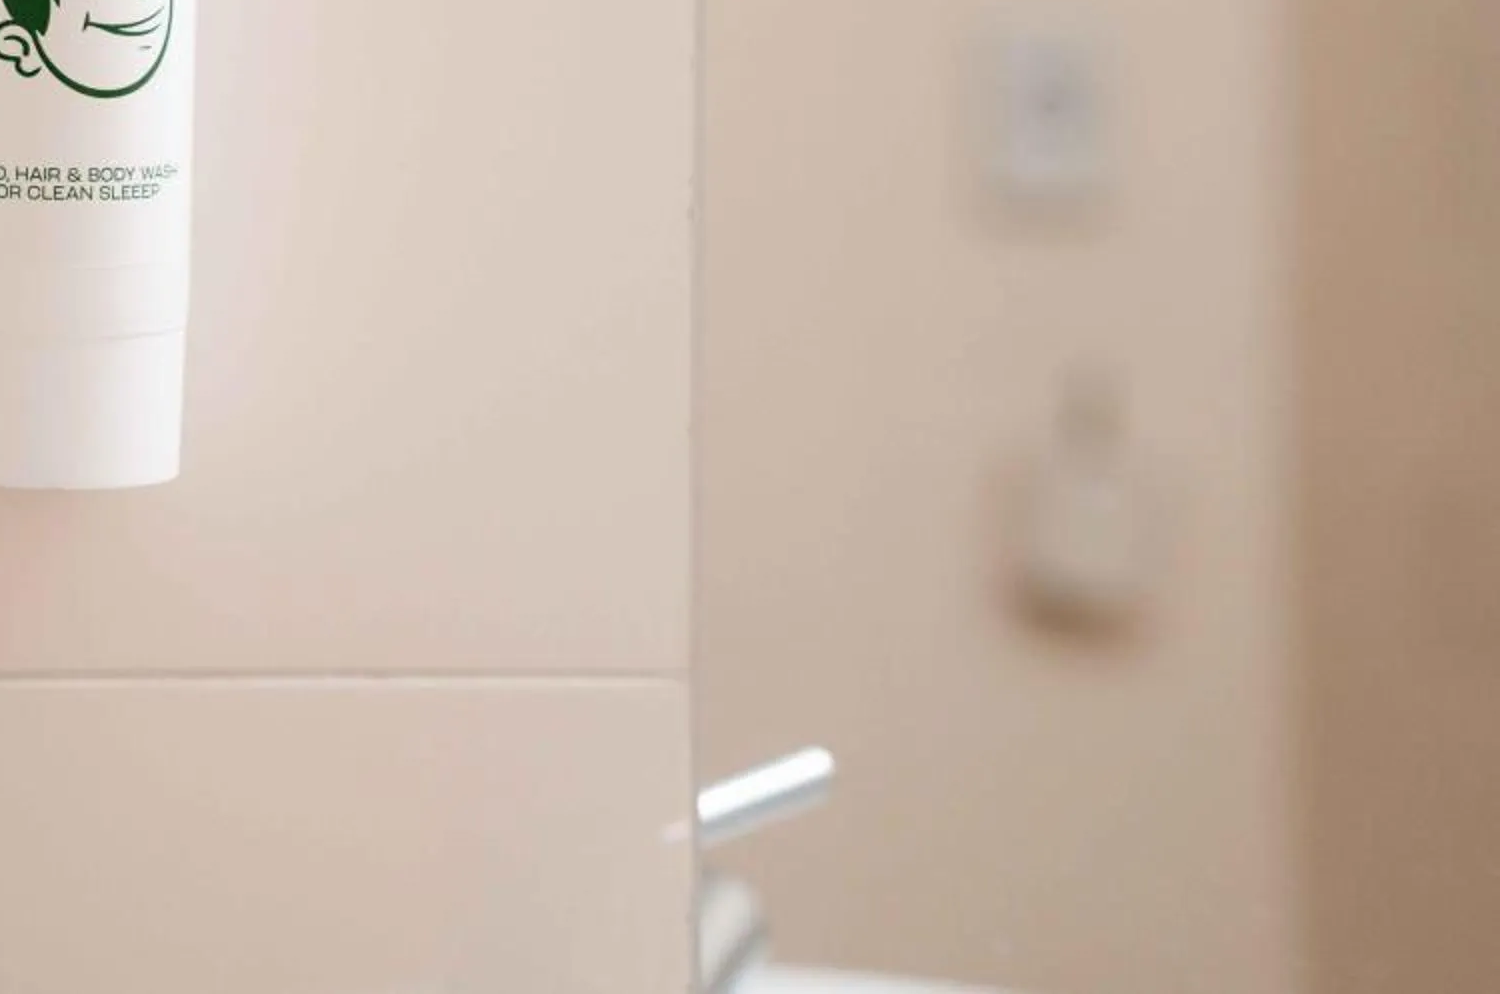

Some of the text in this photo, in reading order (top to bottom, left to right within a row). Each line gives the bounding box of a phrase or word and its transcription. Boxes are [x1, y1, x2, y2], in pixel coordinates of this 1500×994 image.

[15, 166, 61, 182] HAIR
[67, 167, 82, 182] &
[88, 167, 136, 183] BODY
[28, 185, 93, 201] CLEAN
[99, 183, 161, 201] SLEEEP
